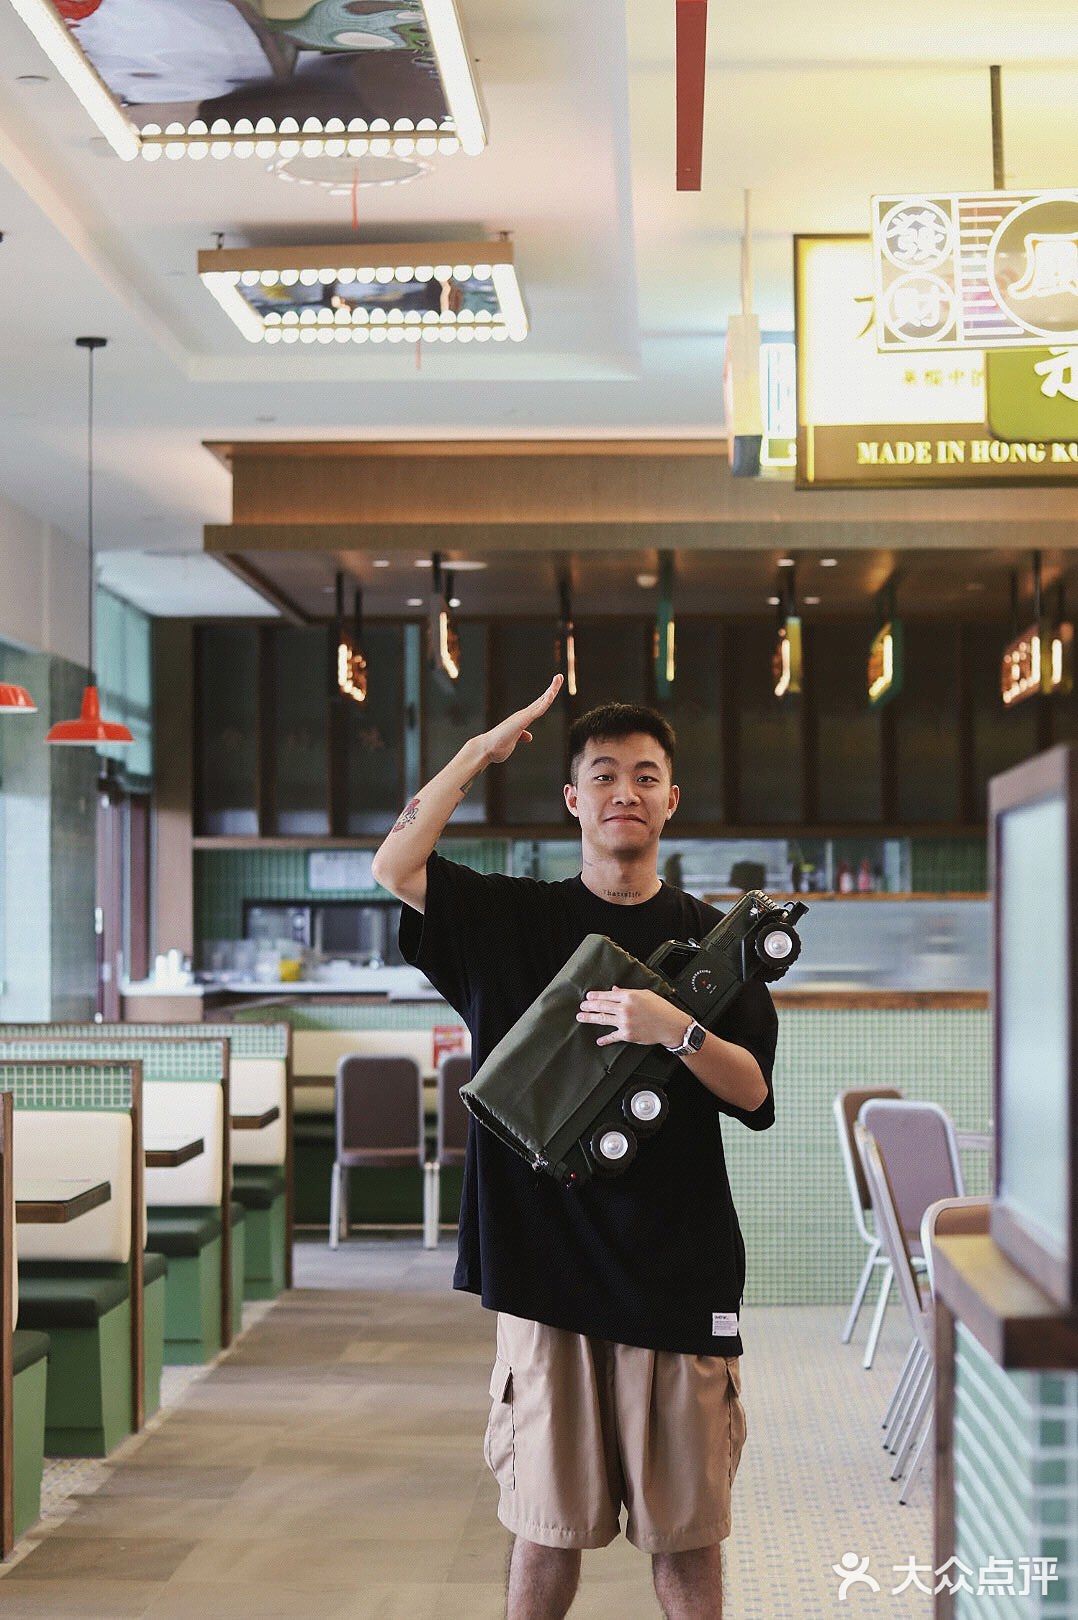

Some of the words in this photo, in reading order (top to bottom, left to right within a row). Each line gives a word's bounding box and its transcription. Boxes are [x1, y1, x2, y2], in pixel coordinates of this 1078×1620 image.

[857, 441, 931, 465] MADE
[936, 440, 966, 464] IN
[970, 440, 1046, 464] HONG
